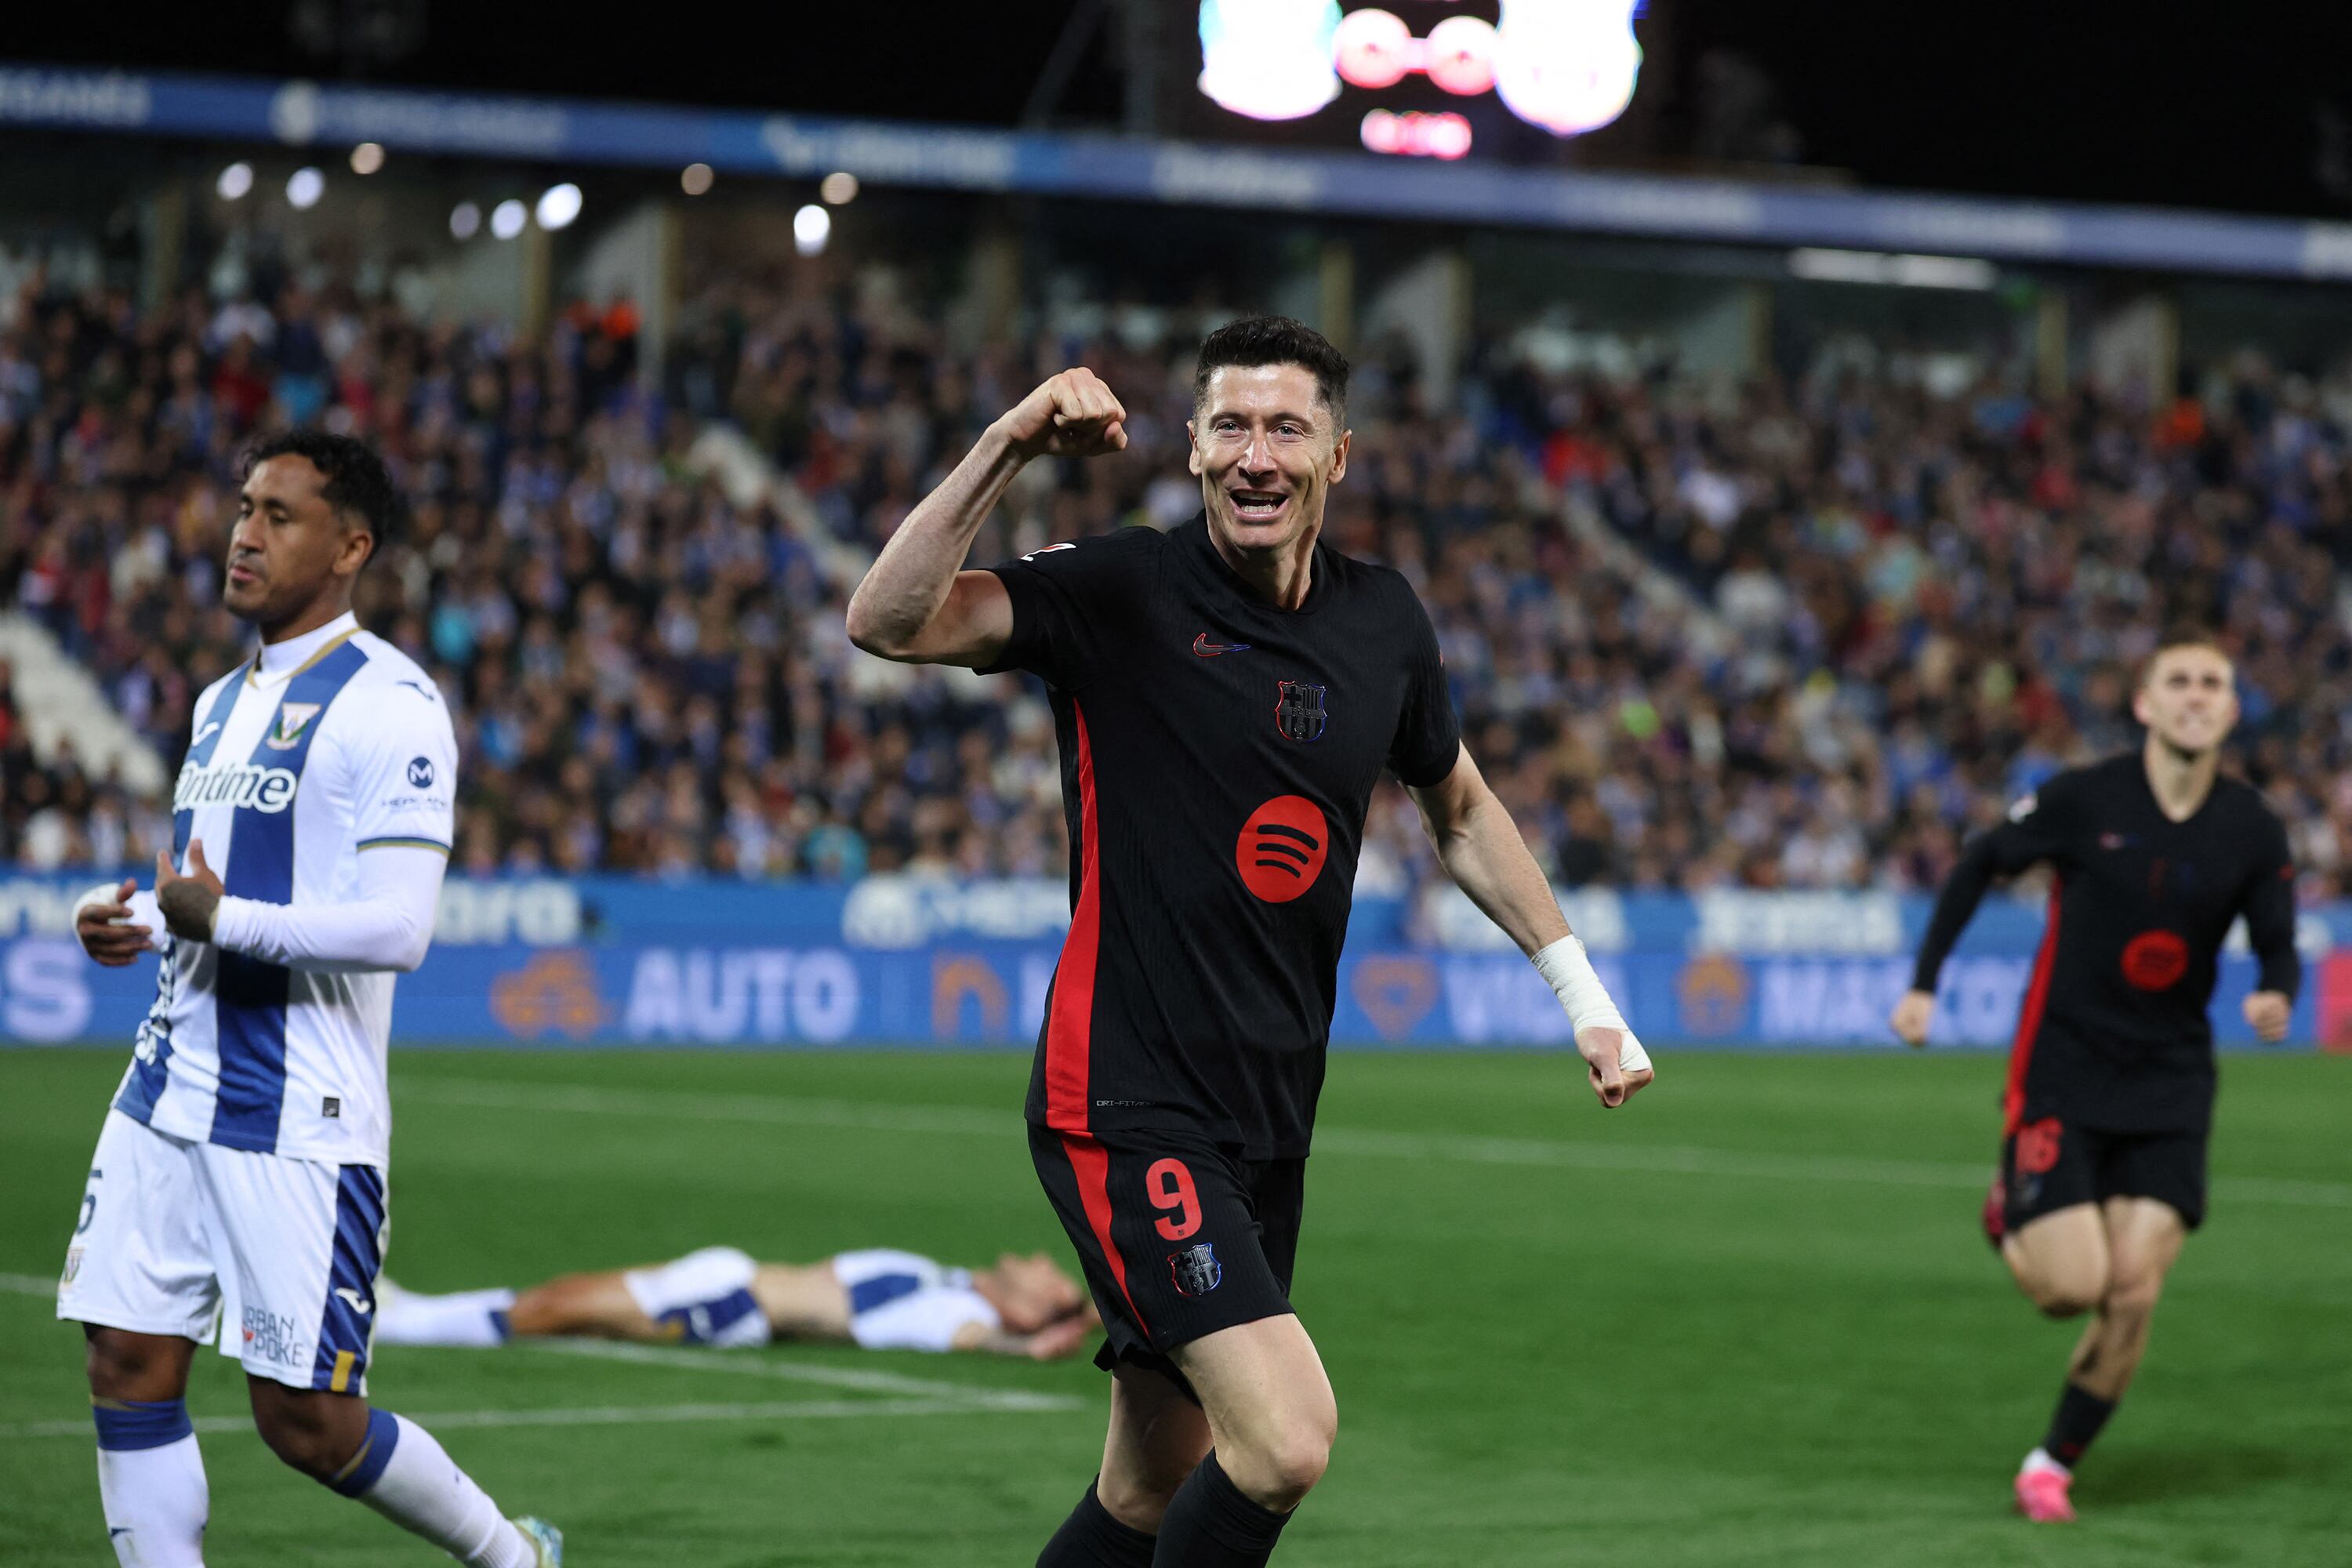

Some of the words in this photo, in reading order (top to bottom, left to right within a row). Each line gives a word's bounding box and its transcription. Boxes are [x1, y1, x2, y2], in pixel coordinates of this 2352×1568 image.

[626, 949, 861, 1046] AUTO
[1145, 1157, 1203, 1241] 9
[241, 1305, 295, 1341] RBAN
[254, 1332, 305, 1368] POKE
